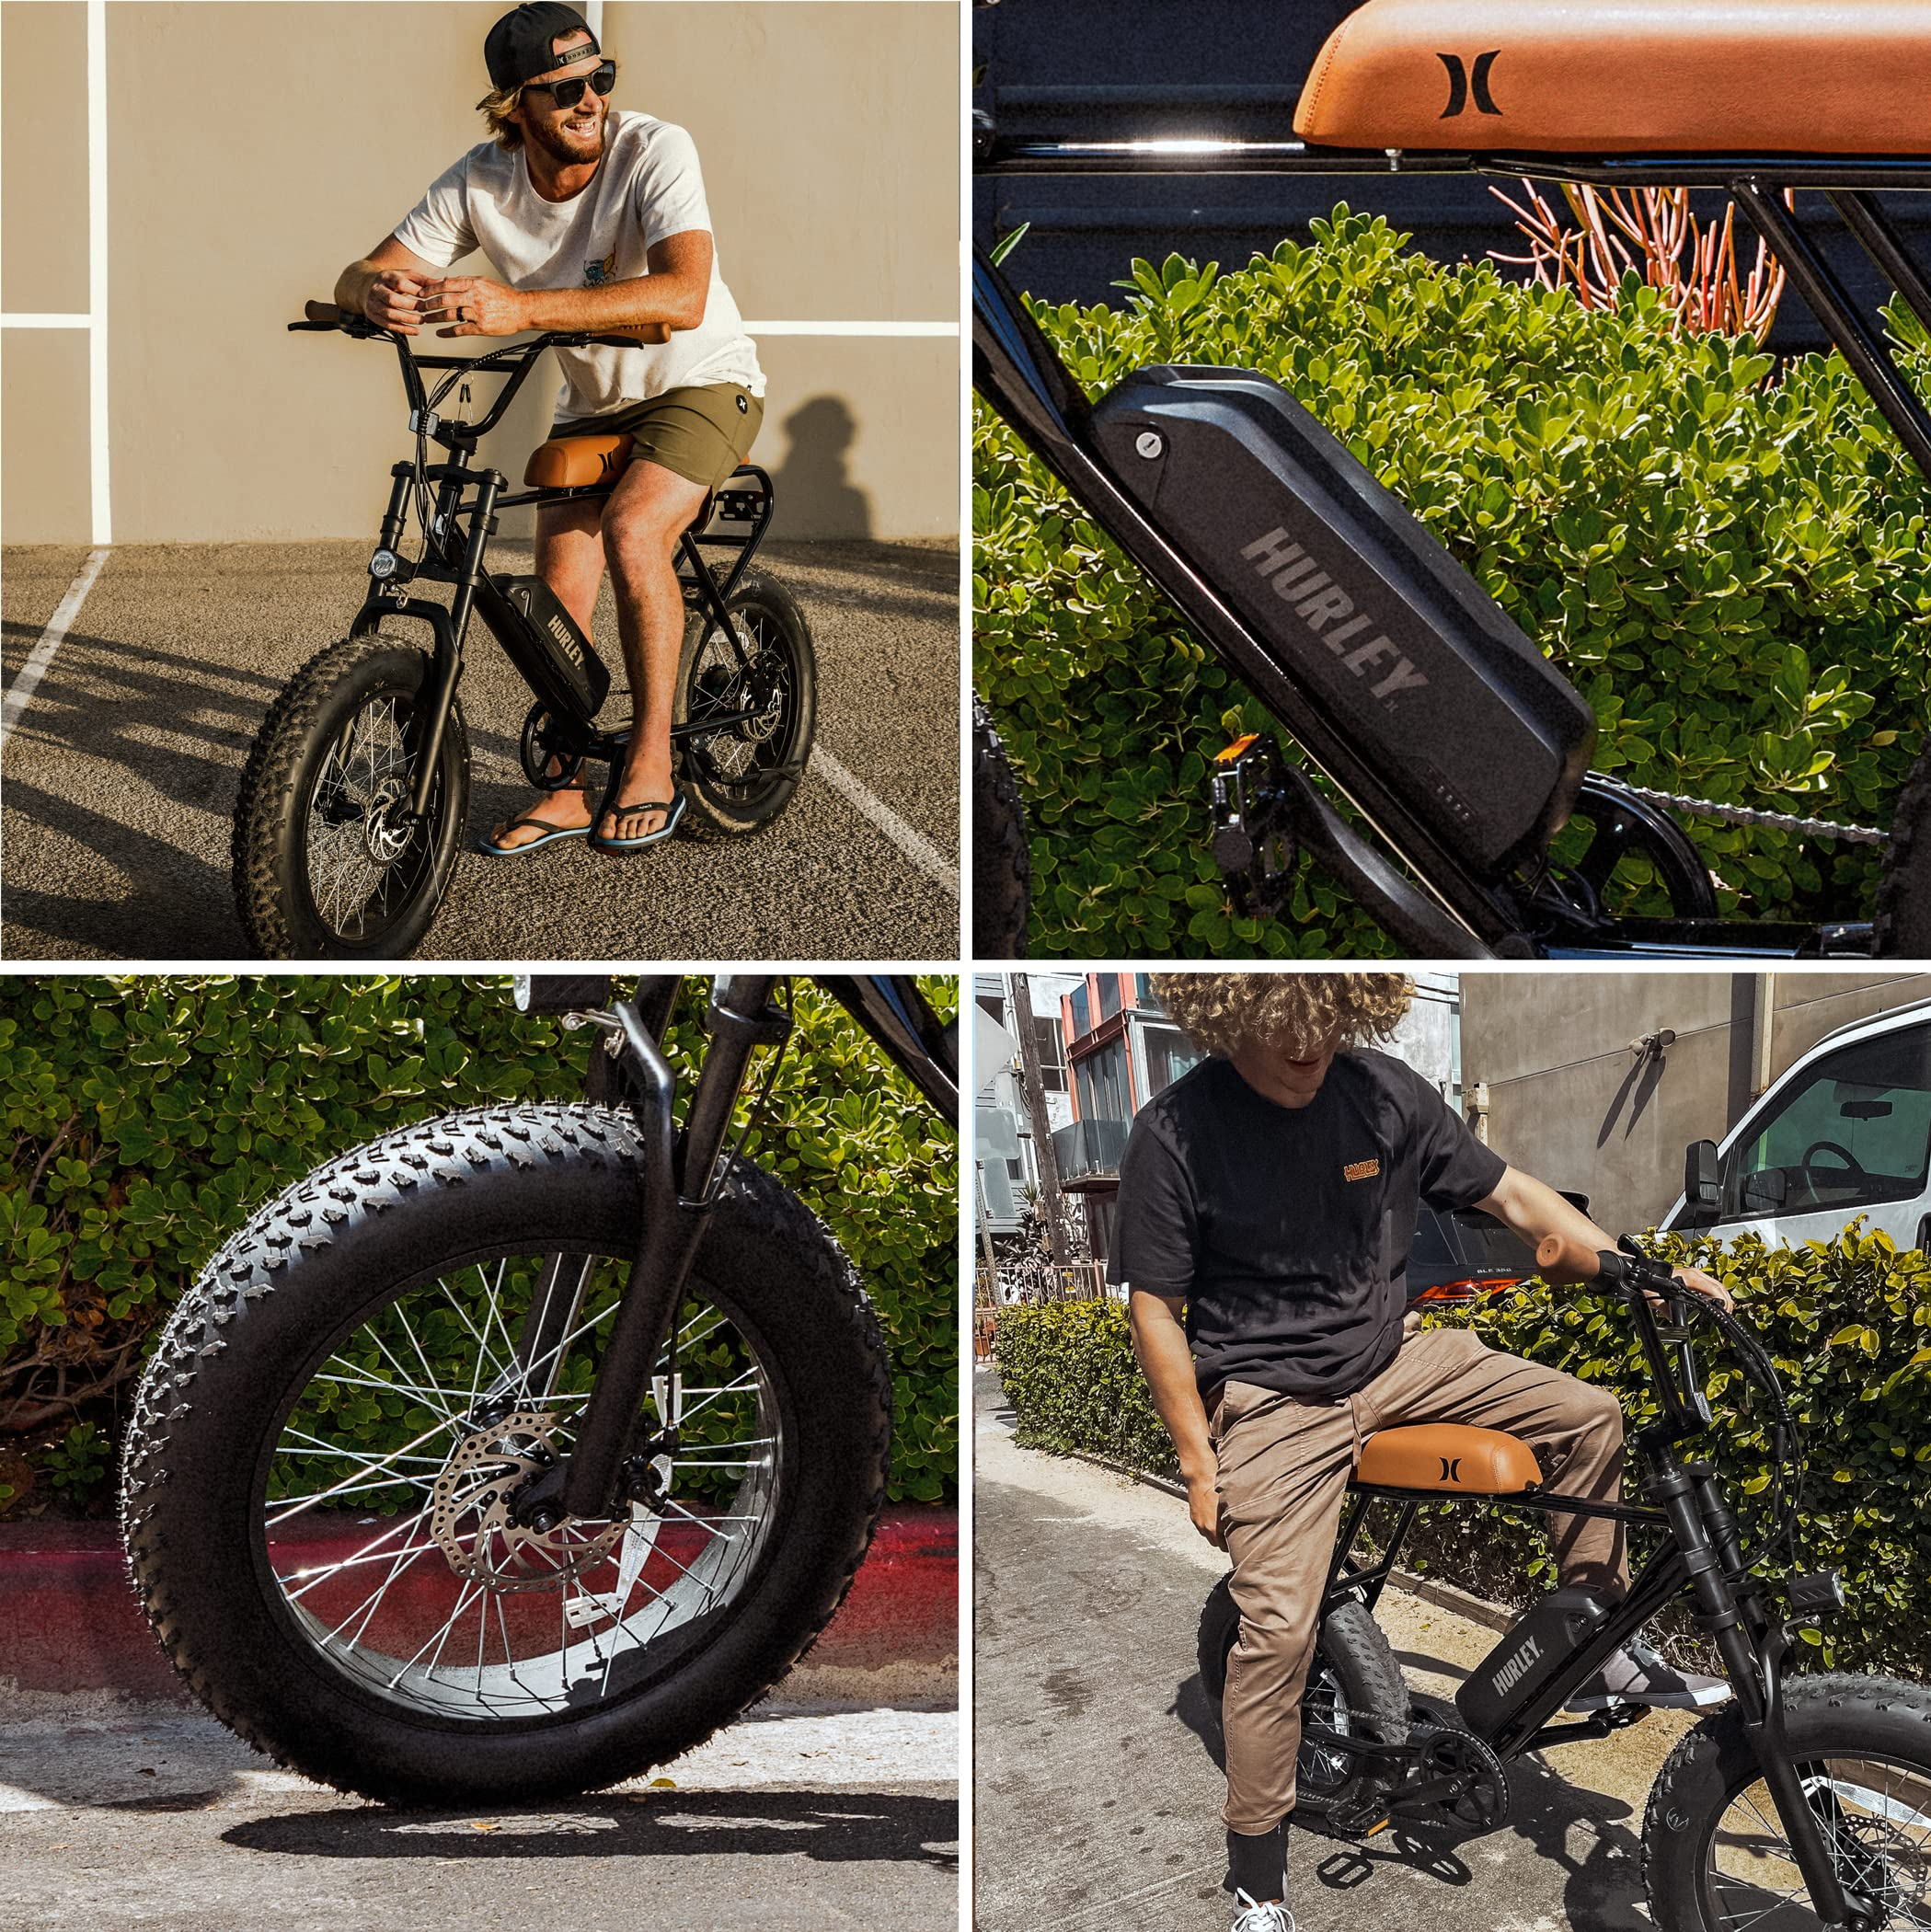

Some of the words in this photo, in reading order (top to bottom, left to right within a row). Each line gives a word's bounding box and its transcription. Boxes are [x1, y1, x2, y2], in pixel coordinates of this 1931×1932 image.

[547, 615, 584, 667] HURLEY
[1240, 526, 1429, 698] HURLEY
[1491, 1635, 1541, 1697] HURLEY
